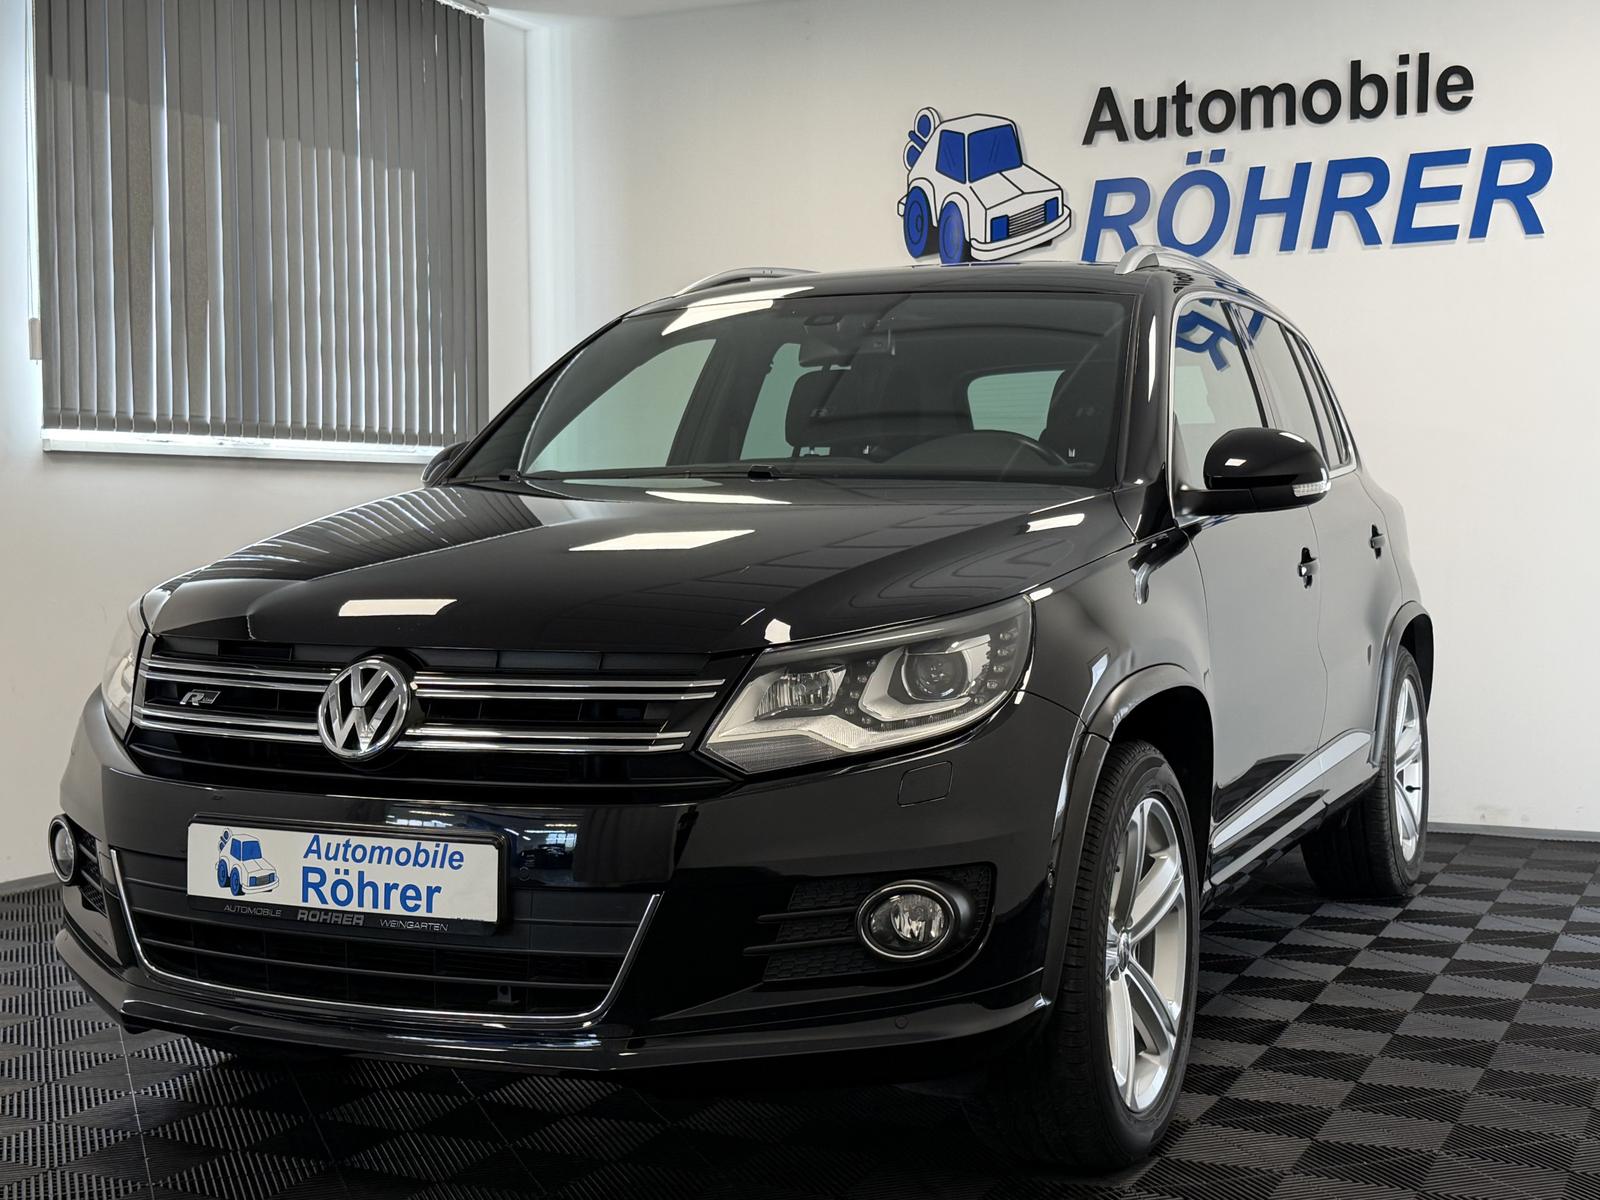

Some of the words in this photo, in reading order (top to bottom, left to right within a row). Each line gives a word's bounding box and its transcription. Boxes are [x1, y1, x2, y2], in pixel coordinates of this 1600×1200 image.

[1082, 52, 1475, 146] Automobile
[1081, 142, 1554, 263] RÖHRER
[303, 834, 465, 870] Automobile
[302, 865, 442, 914] Röhrer
[224, 904, 282, 917] AUTOMOBILE
[379, 919, 449, 932] WEINGARTEN
